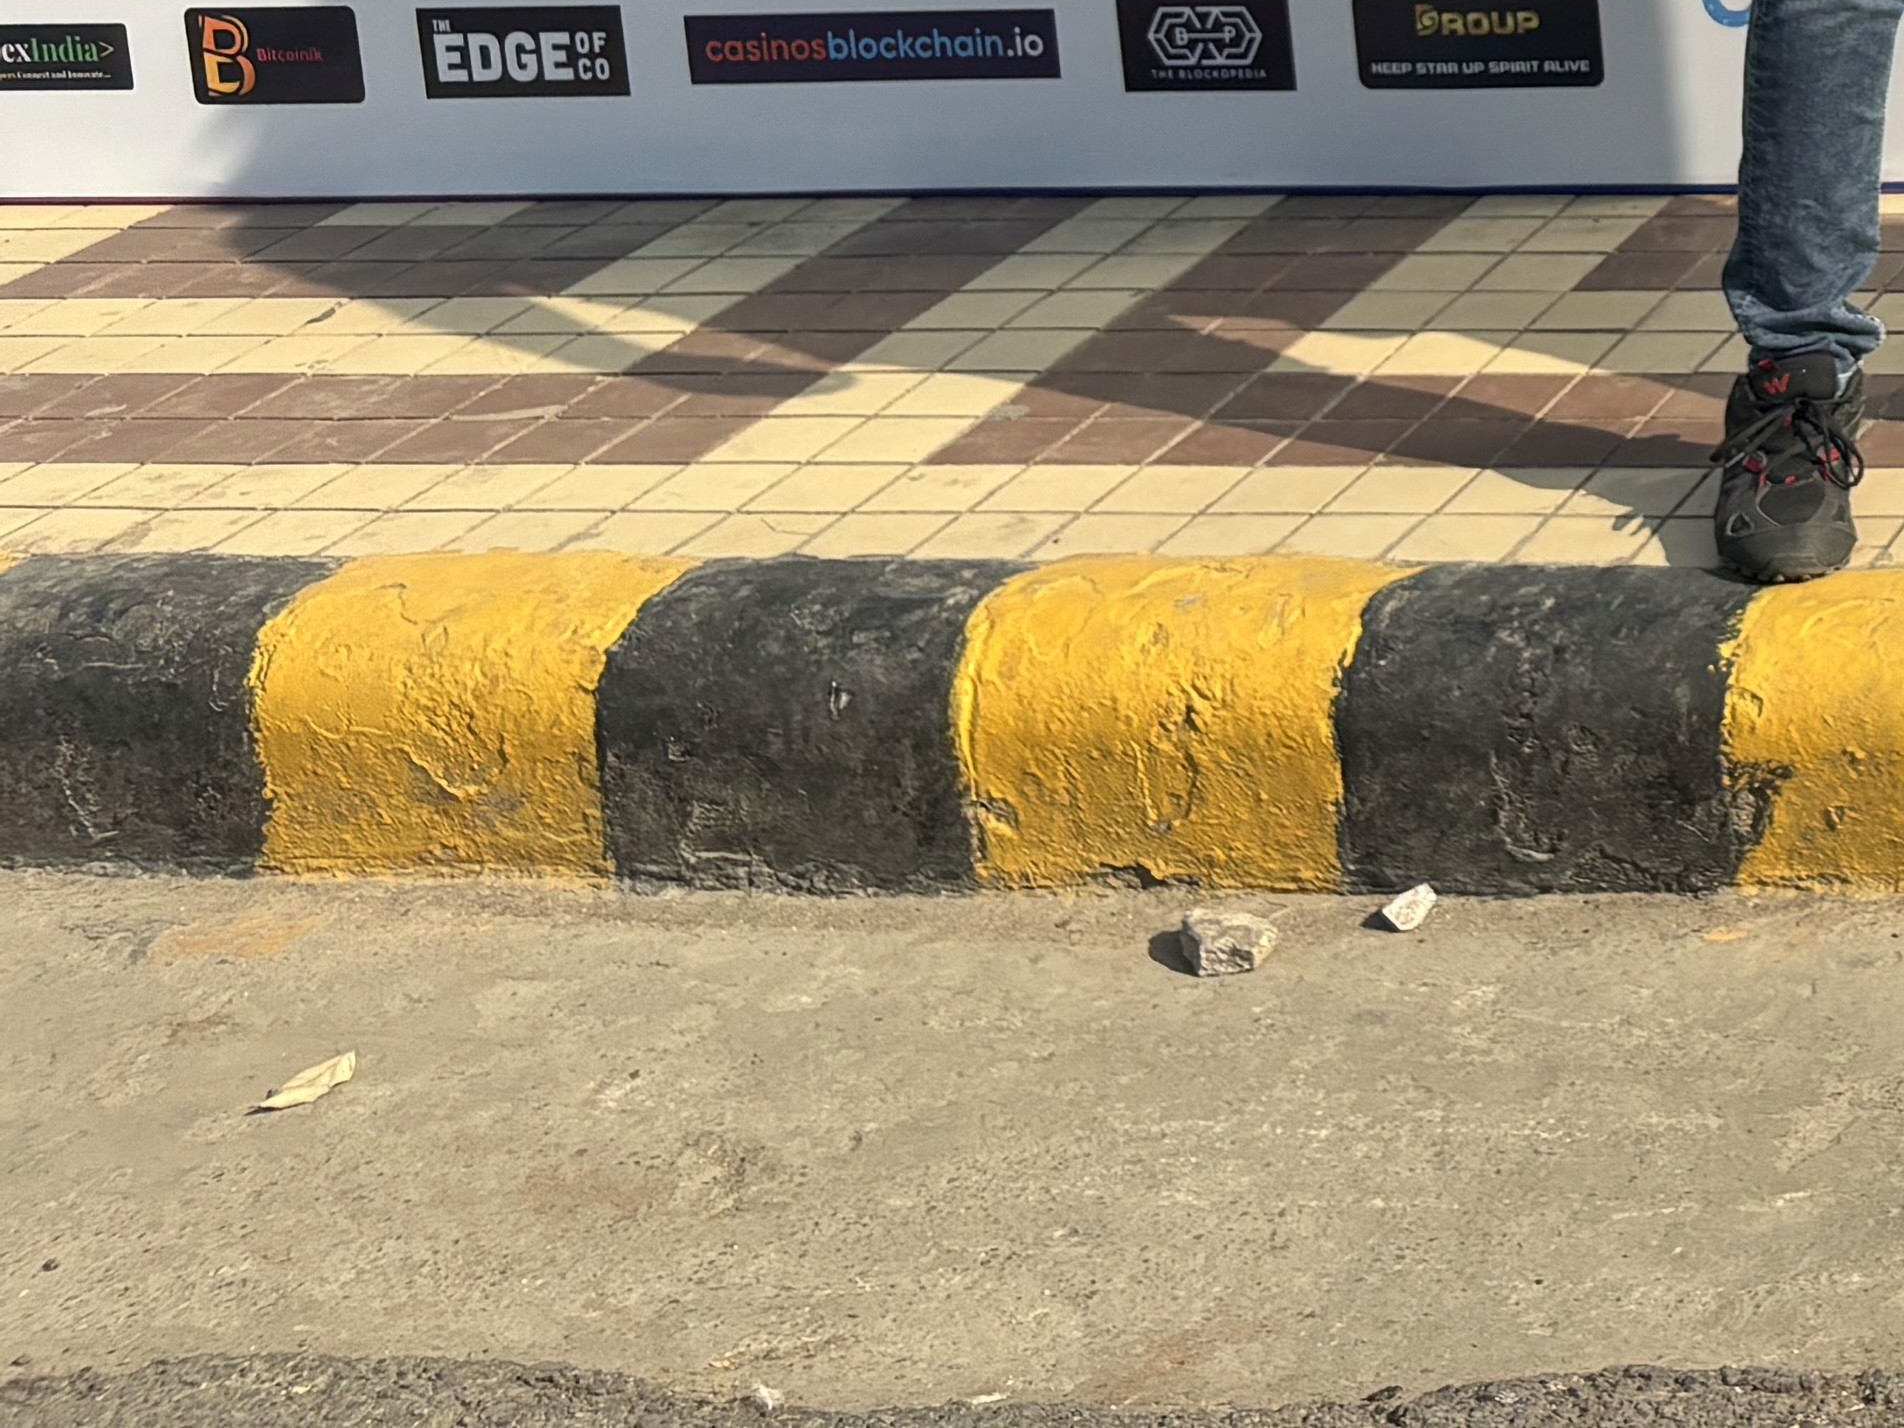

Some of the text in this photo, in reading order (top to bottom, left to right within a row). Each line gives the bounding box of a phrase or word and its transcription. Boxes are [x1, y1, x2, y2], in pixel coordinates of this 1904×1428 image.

[432, 20, 450, 32] THE
[433, 31, 606, 83] EDGE OF
[706, 27, 1043, 64] casinosblockchain.io
[578, 56, 609, 82] CO
